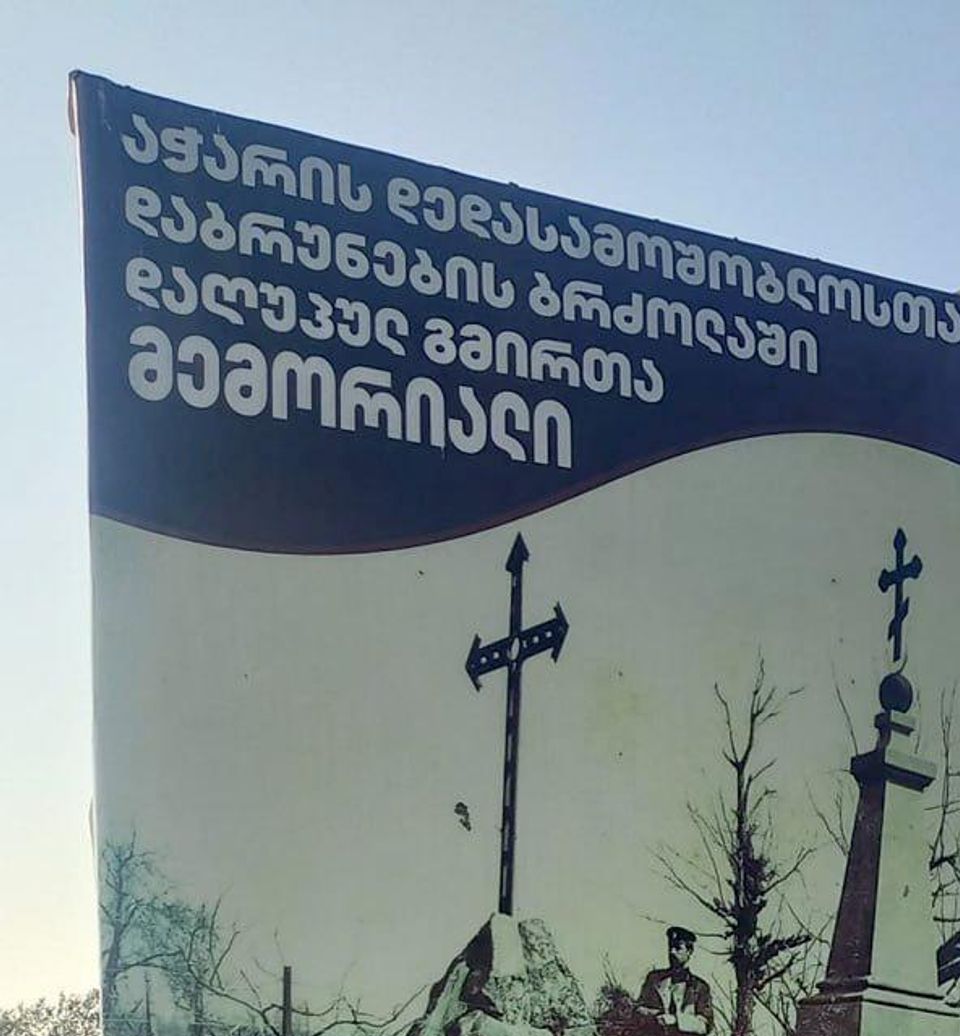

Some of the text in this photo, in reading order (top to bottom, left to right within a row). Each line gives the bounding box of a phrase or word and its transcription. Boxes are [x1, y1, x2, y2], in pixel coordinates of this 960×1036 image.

[121, 113, 373, 213] აჭარის
[125, 185, 819, 375] დაბრუნების ბრძოლაში
[125, 256, 666, 403] დაღუპულ გმირთა
[127, 324, 573, 470] მემორიალი
